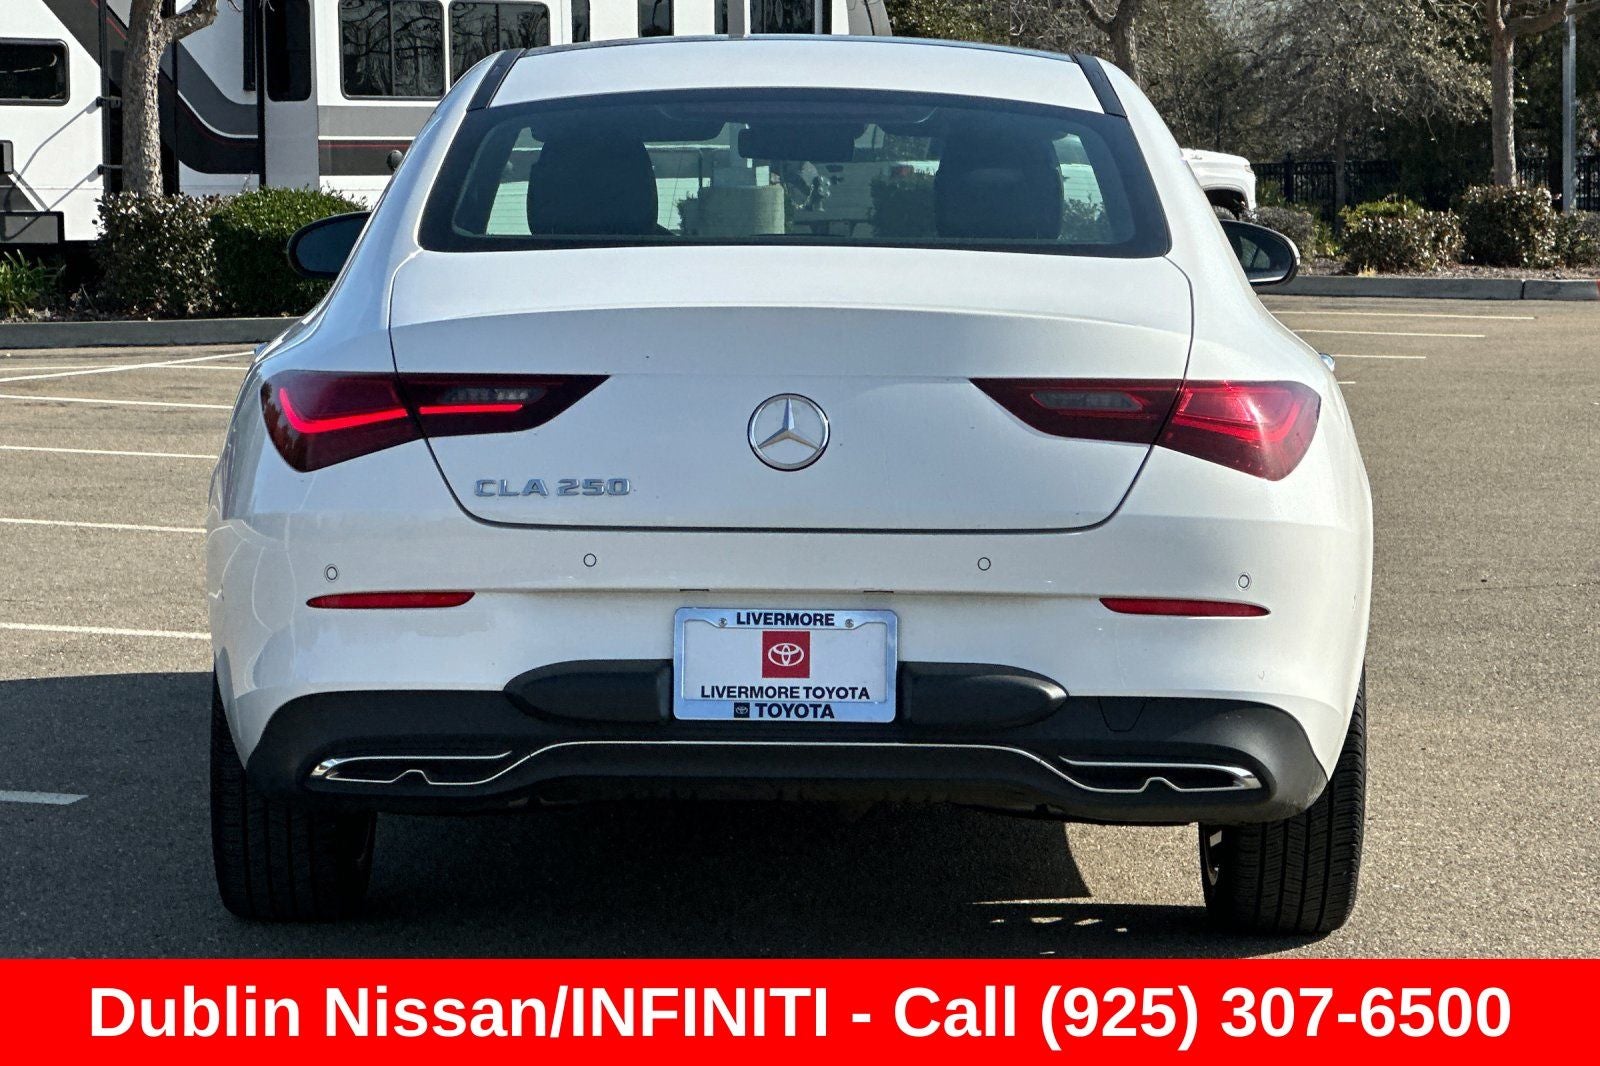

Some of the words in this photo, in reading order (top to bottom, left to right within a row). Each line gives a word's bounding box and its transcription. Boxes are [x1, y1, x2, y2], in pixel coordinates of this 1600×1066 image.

[474, 478, 549, 497] CLA
[557, 478, 631, 497] 250
[736, 611, 835, 627] LIVERMORE
[700, 685, 800, 699] LIVERMORE
[805, 686, 870, 700] TOYOTA
[755, 702, 835, 719] TOYOTA
